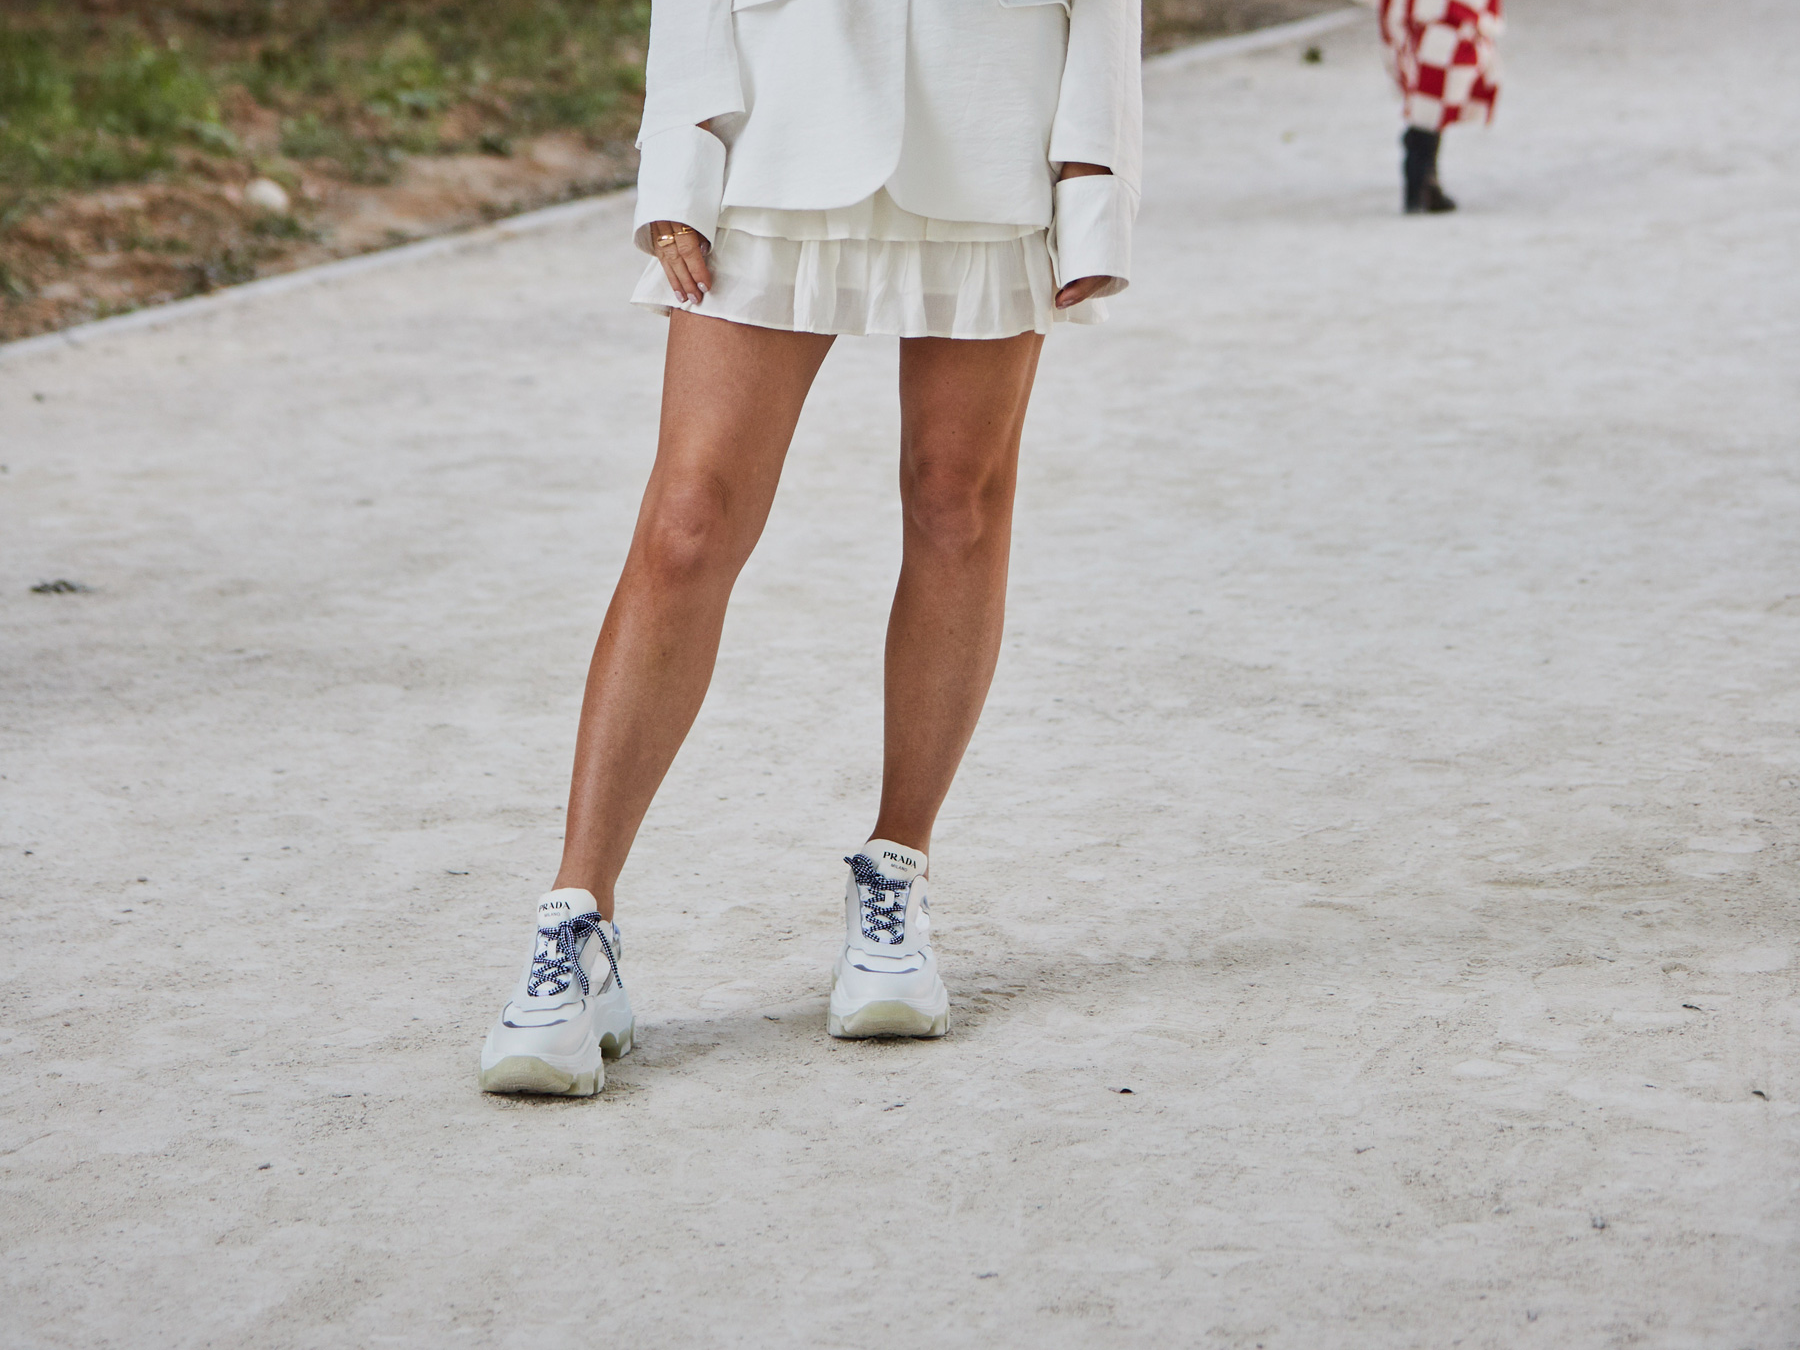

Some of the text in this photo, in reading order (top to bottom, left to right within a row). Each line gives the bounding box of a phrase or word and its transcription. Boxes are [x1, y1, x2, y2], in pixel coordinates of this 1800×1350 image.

[883, 851, 916, 869] PRADA
[890, 863, 908, 872] MILANO
[538, 901, 570, 912] PRADA
